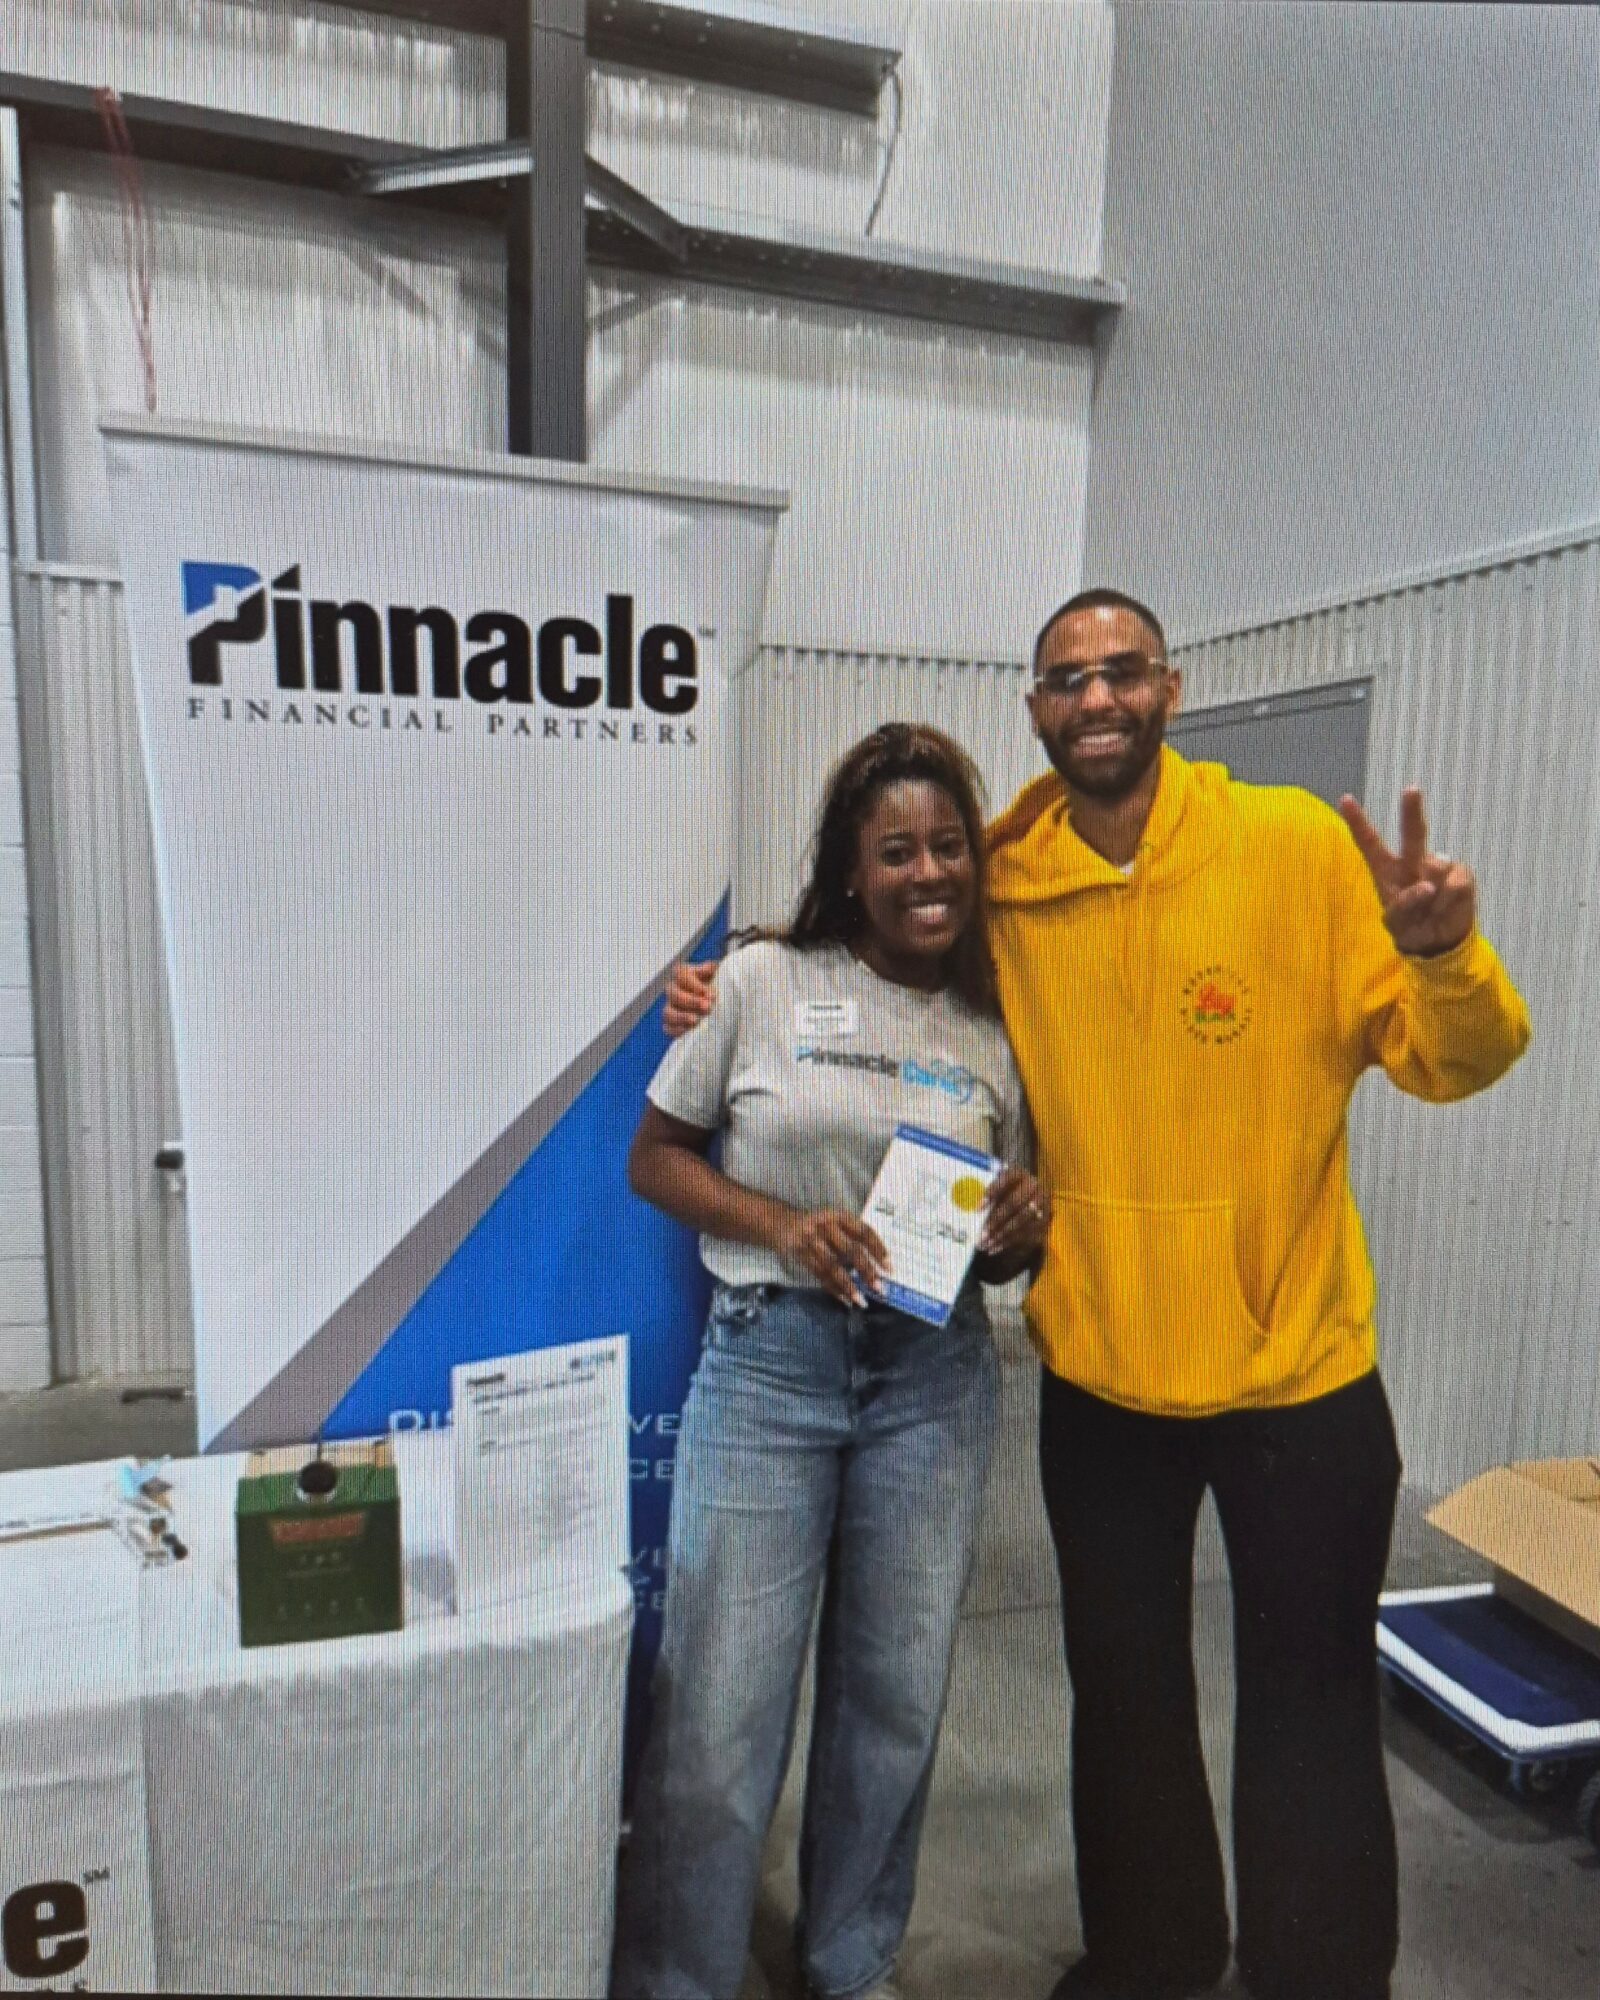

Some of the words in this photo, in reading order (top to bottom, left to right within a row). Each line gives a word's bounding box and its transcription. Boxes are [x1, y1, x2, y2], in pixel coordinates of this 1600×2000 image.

[181, 561, 698, 715] Pinnacle
[187, 698, 453, 734] FINANCIAL
[487, 713, 699, 746] PARTNERS
